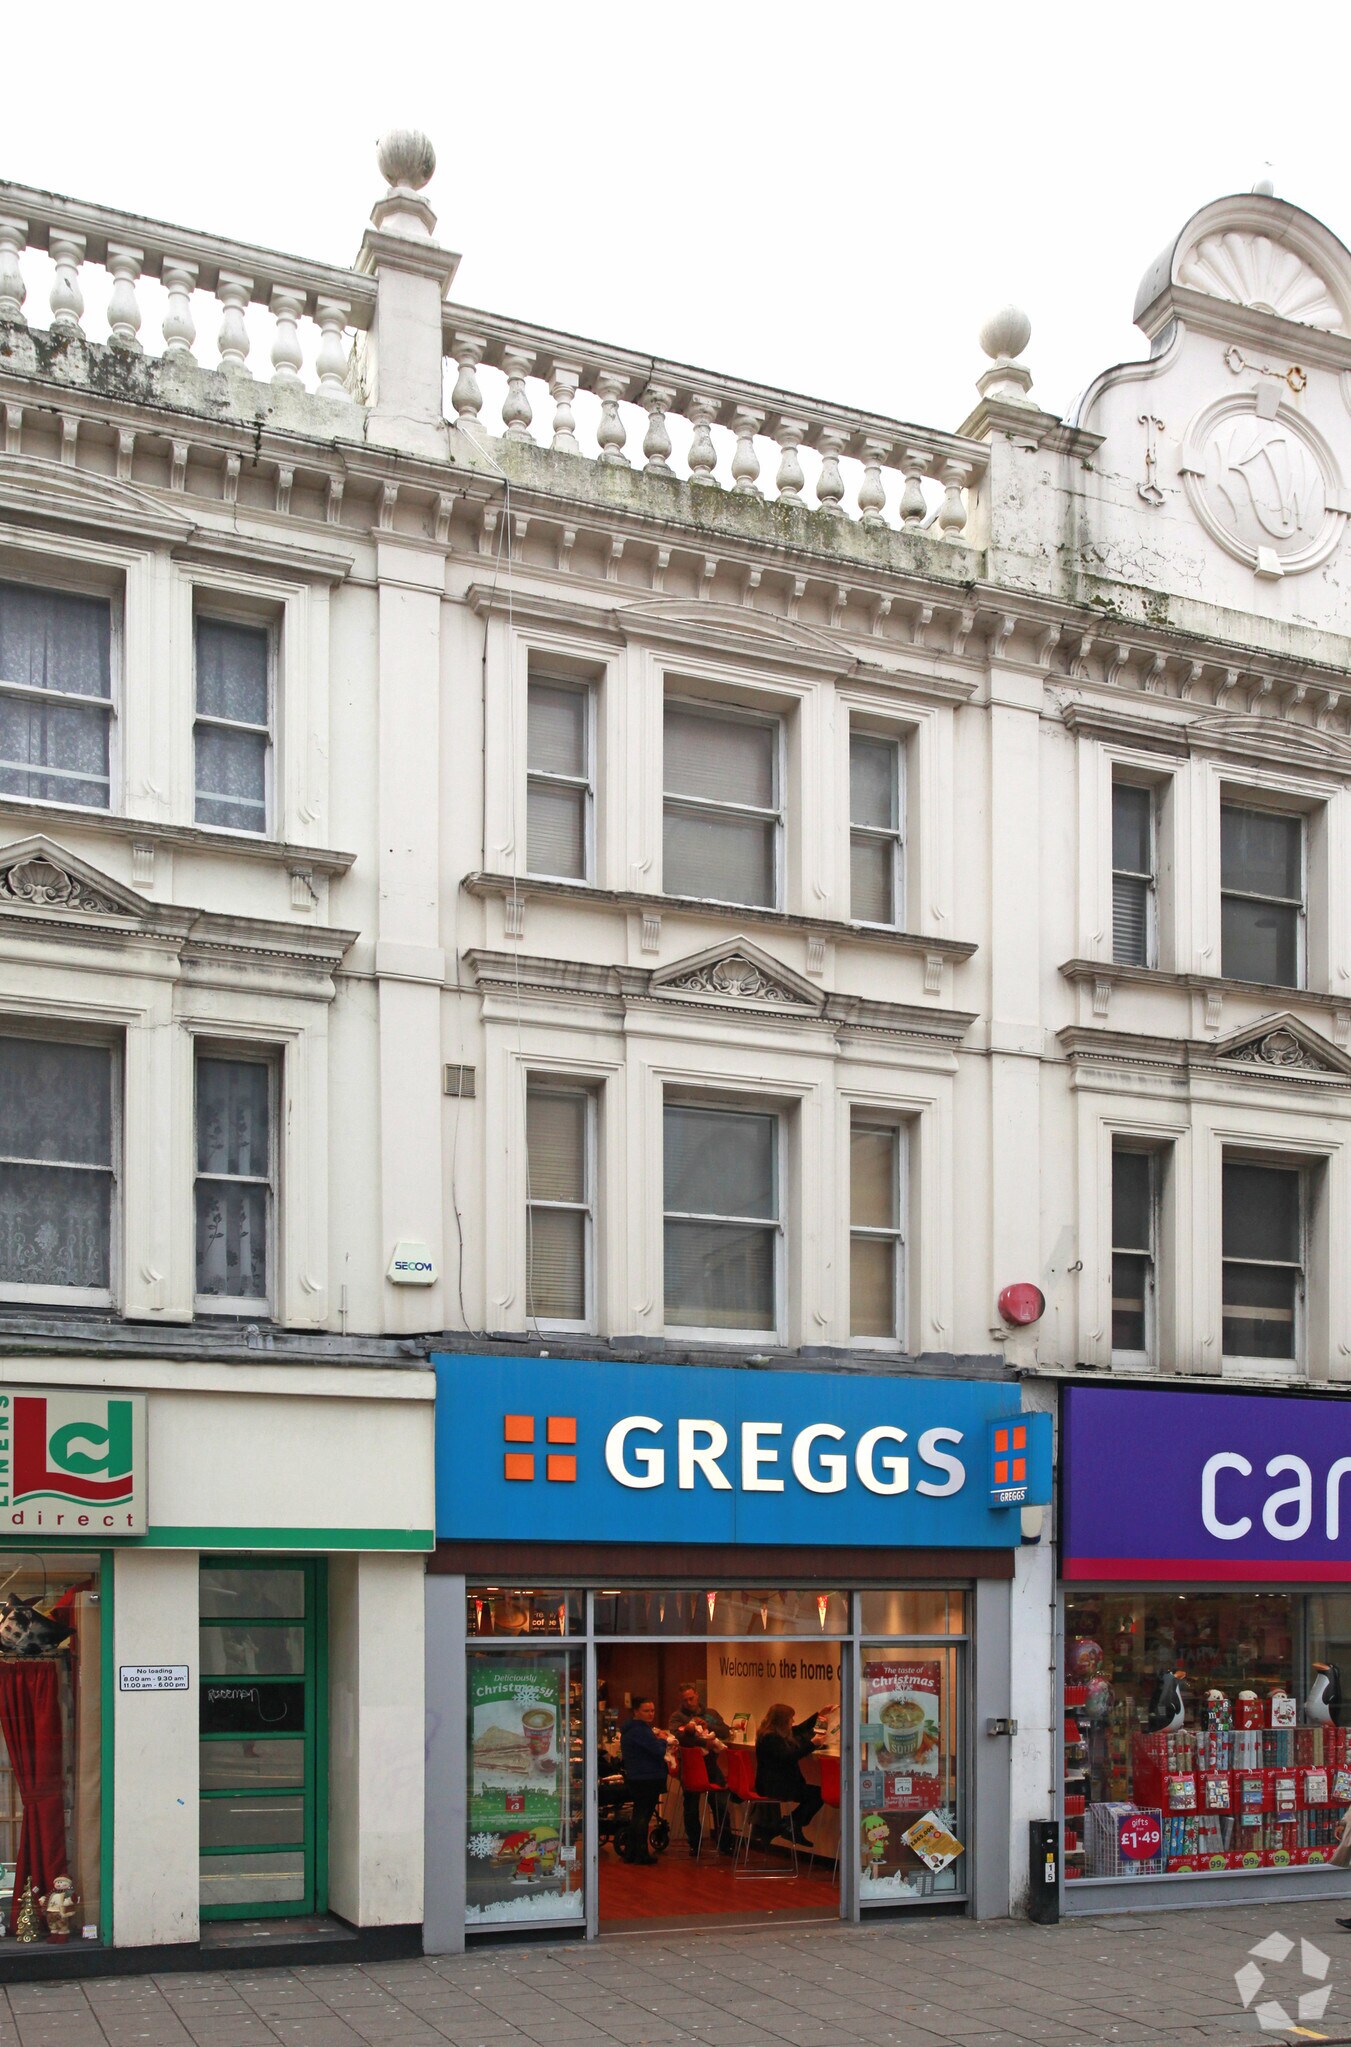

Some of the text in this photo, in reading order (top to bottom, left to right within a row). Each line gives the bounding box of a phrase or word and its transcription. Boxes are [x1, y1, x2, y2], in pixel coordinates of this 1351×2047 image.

[395, 1261, 432, 1271] SECOM
[604, 1415, 966, 1497] GREGGS
[1000, 1490, 1025, 1502] GREGGS
[11, 1510, 133, 1527] direct
[719, 1657, 764, 1678] Welcome
[766, 1660, 777, 1678] to
[779, 1658, 797, 1679] the
[800, 1659, 833, 1681] home
[494, 1674, 537, 1683] Deliciously
[872, 1674, 935, 1688] Christmas
[476, 1682, 554, 1697] Christmassy
[1131, 1818, 1149, 1828] gifts
